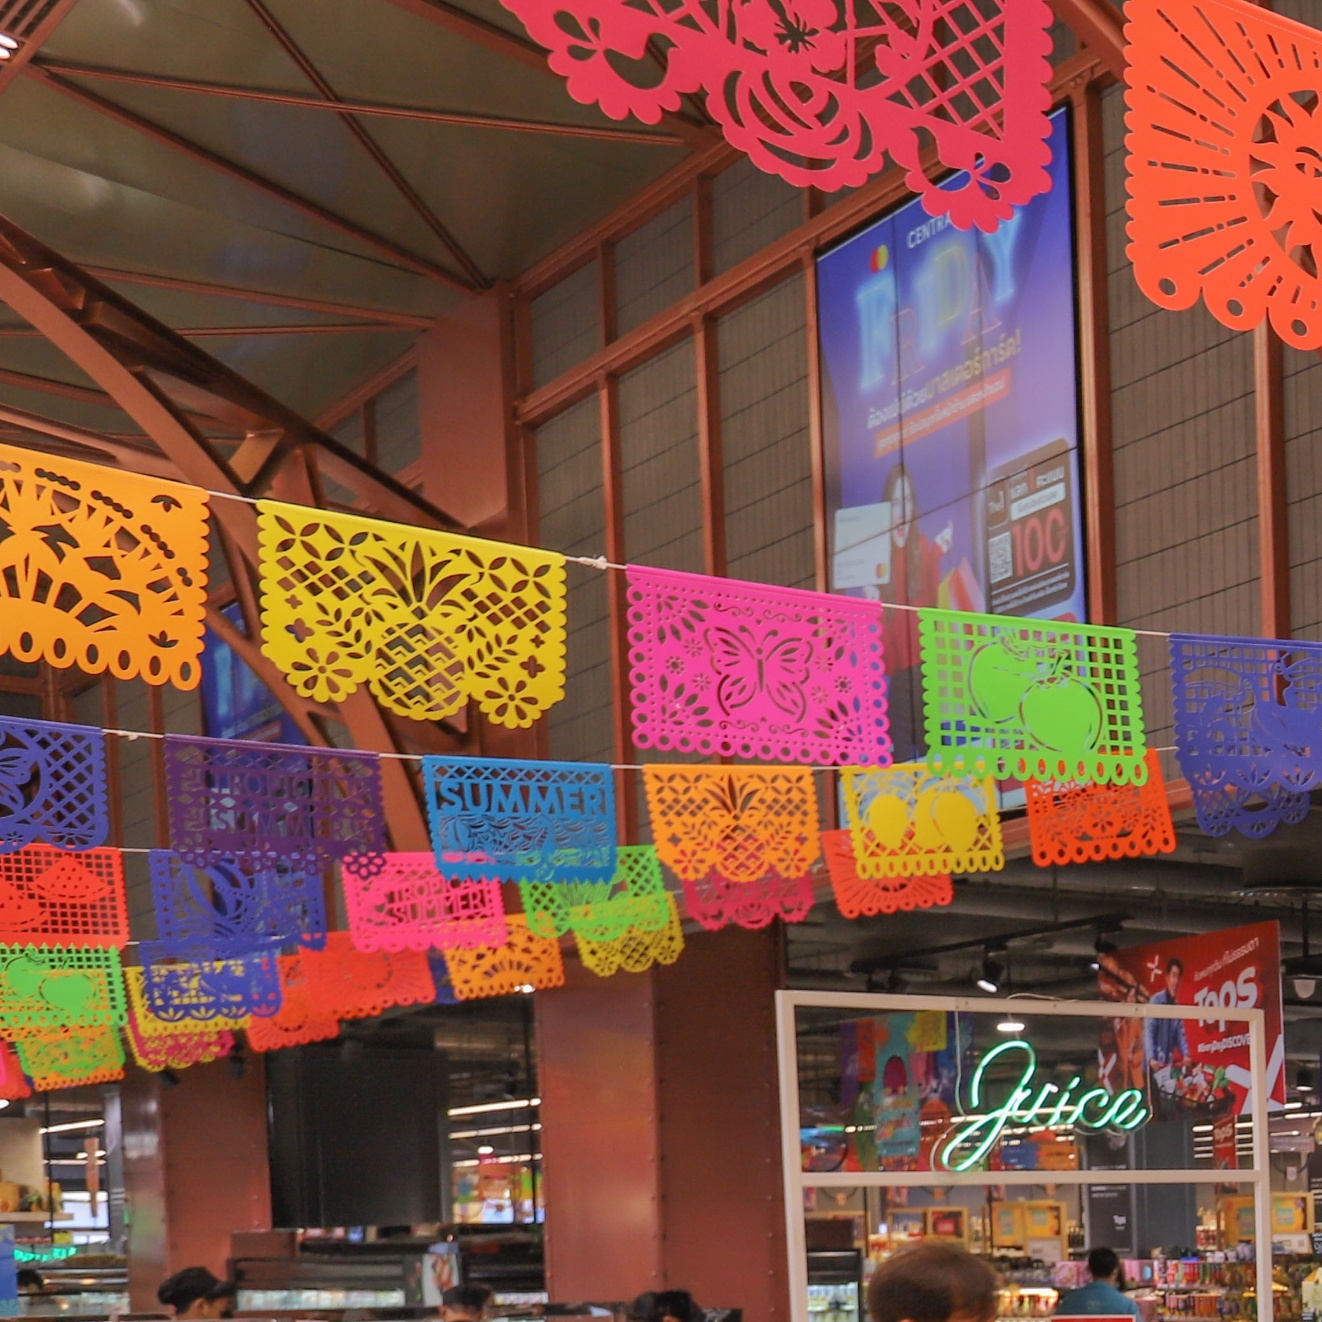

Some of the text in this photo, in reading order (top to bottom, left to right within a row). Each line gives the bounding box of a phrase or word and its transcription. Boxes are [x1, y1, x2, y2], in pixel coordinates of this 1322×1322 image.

[907, 212, 951, 249] CENTRA
[440, 780, 606, 817] SUMMER
[1194, 966, 1258, 1032] Tops
[942, 1040, 1148, 1171] Juice
